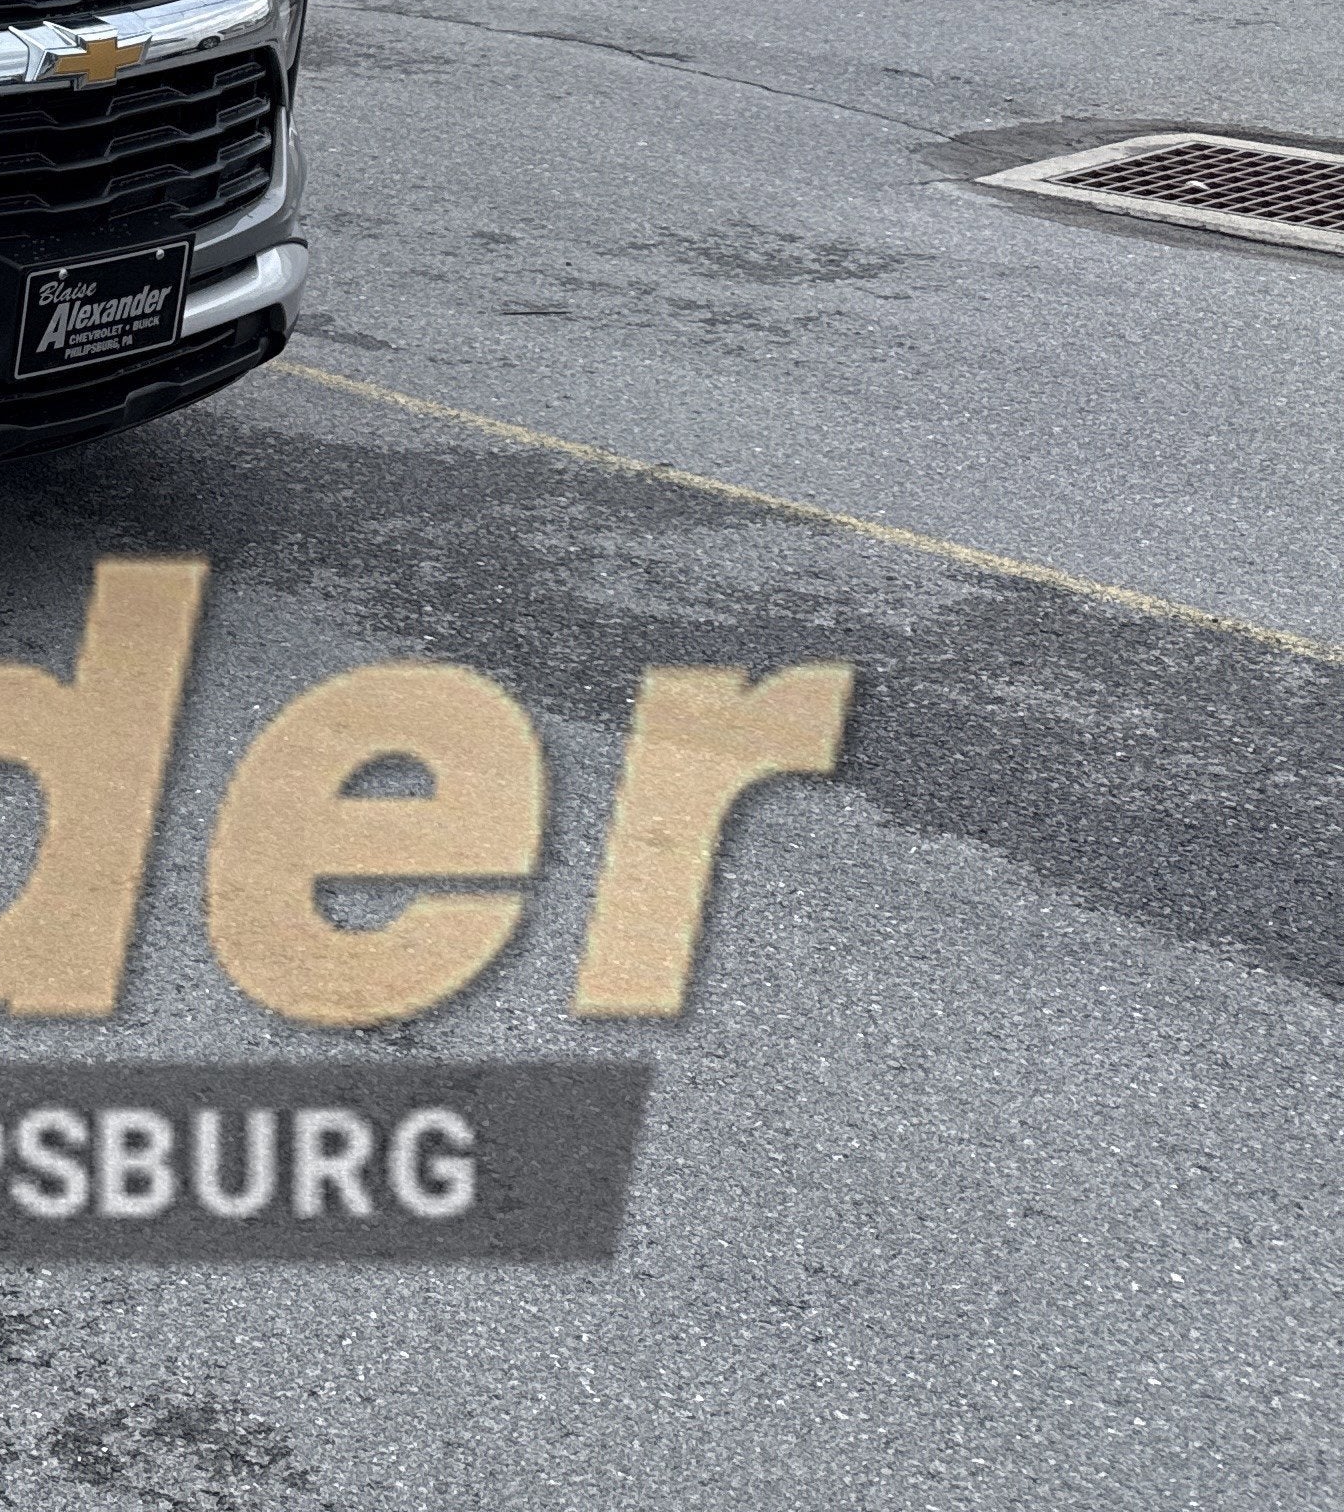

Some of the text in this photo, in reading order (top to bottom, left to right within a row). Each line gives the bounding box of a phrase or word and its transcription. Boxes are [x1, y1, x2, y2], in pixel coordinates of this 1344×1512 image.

[39, 281, 97, 306] Blaise
[36, 285, 172, 353] Alexander
[69, 316, 160, 345] CHEVROLET BUICK
[122, 334, 133, 346] PA
